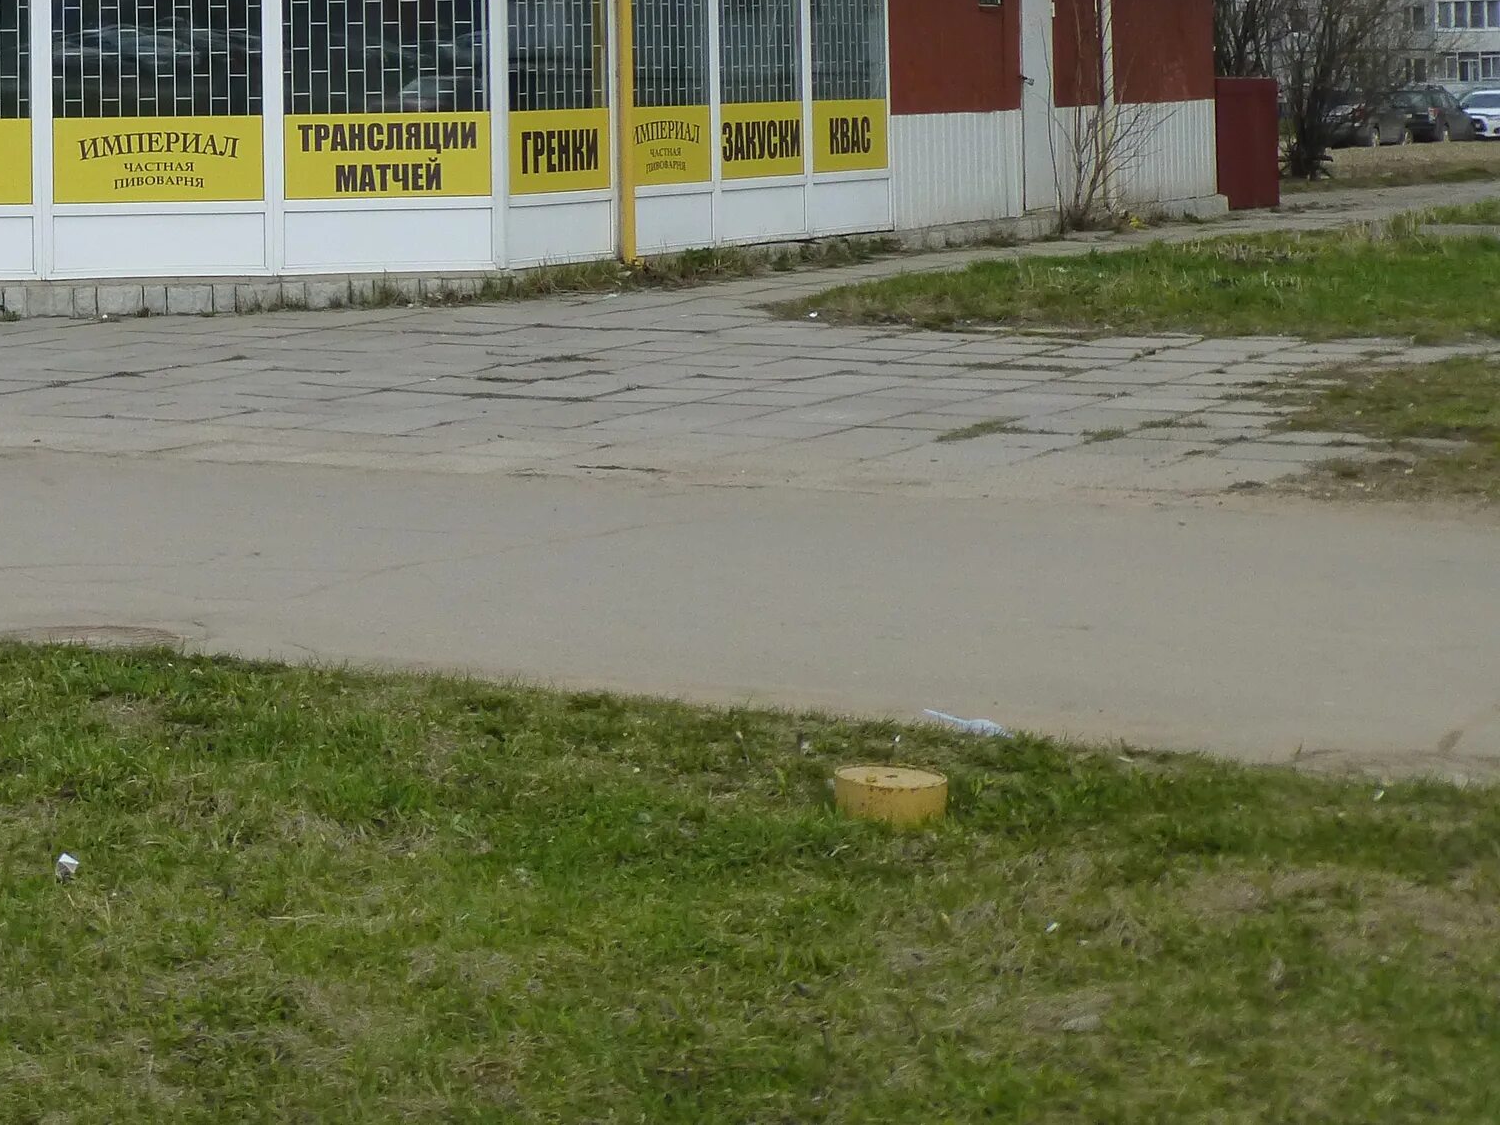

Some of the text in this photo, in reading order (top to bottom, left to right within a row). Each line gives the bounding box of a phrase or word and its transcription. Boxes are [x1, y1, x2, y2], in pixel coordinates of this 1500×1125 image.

[77, 131, 240, 161] ИМПЕРИАЛ
[297, 122, 477, 154] ТРАНСЛЯЦИИ
[521, 128, 598, 175] ГРЕНКИ
[722, 119, 801, 162] ЗАКУСКИ
[829, 116, 872, 155] КВАС
[123, 161, 195, 173] ЧАСТНАЯ
[649, 147, 682, 157] ЧАСТНАЯ
[113, 175, 205, 190] ПИВОВАРНЯ
[335, 157, 442, 192] МАТЧЕЙ
